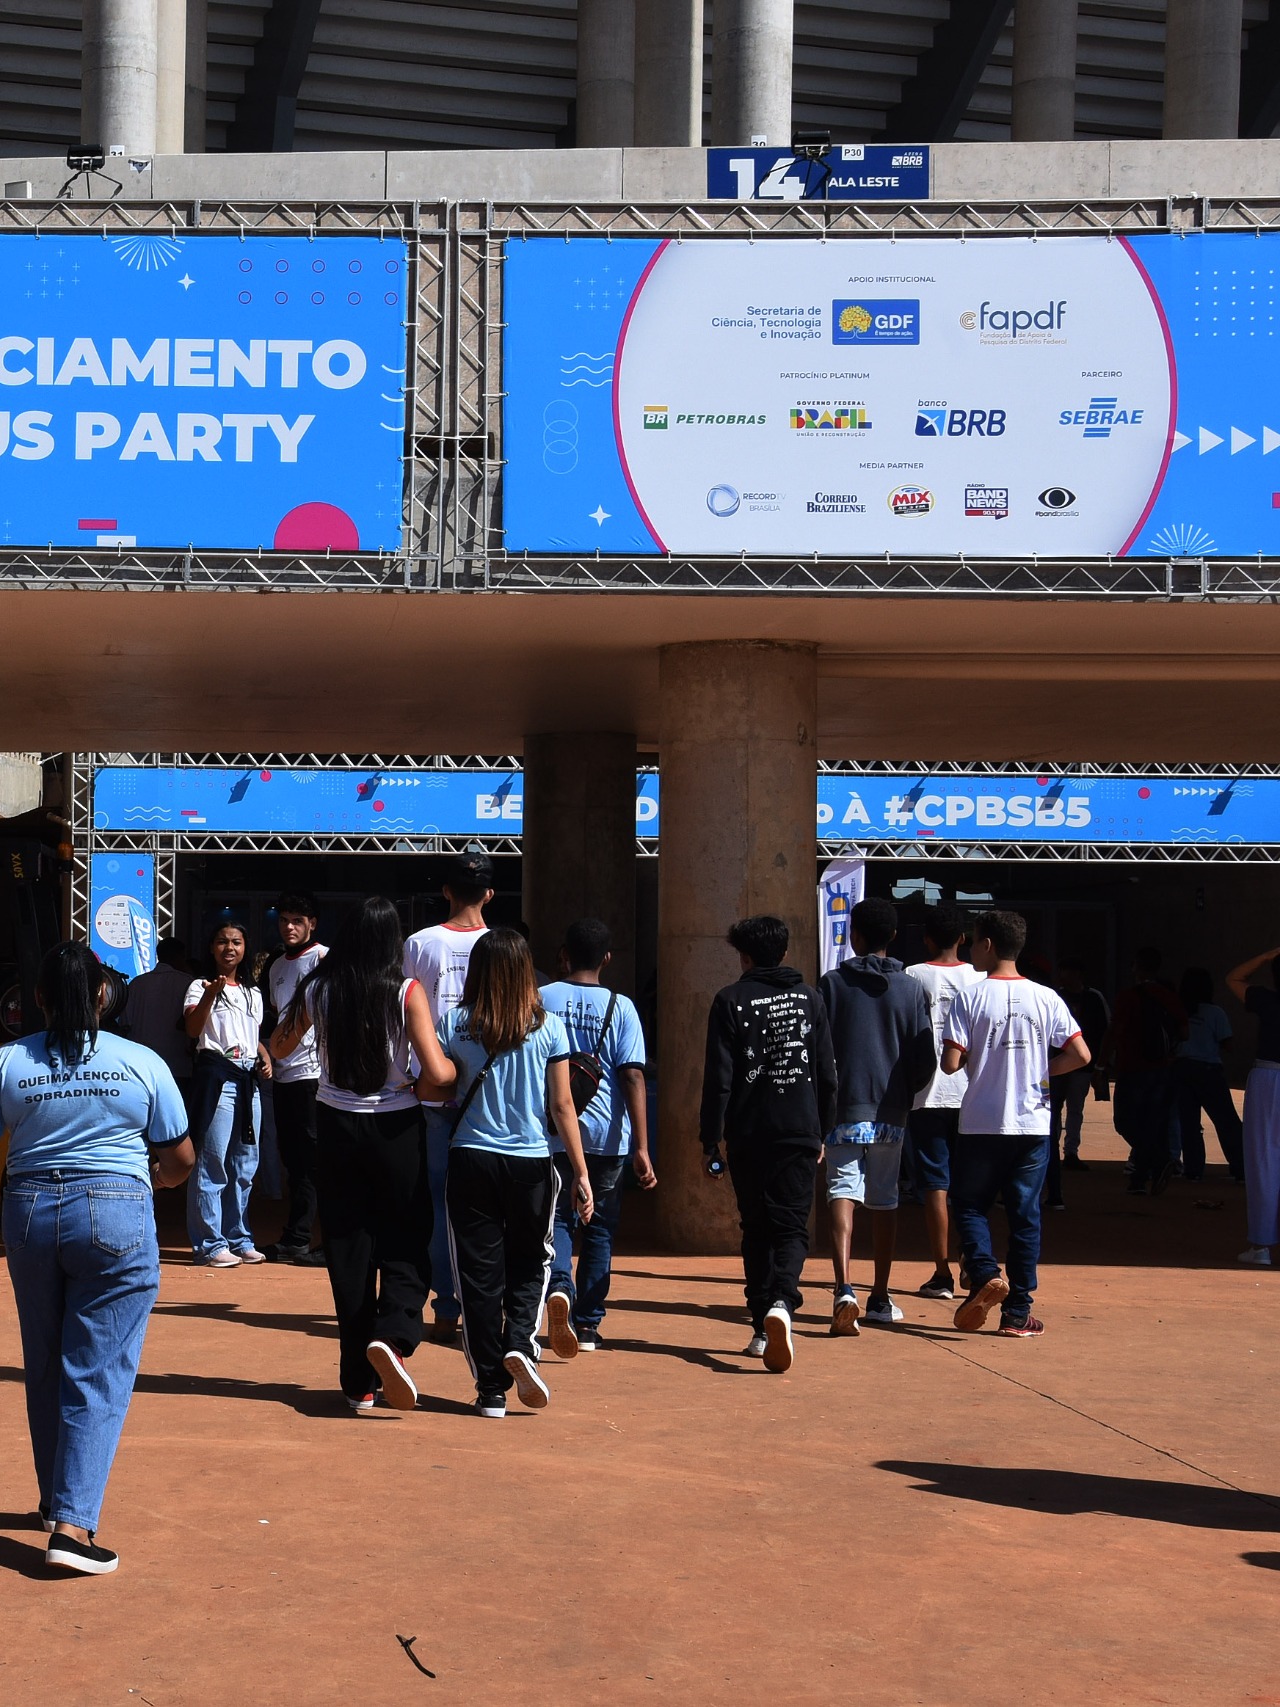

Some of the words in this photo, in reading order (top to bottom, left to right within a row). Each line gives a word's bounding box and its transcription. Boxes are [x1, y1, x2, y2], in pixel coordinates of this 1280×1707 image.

[843, 148, 862, 157] P30
[902, 155, 923, 165] BRB
[729, 158, 805, 200] 14
[828, 177, 856, 187] ALA
[859, 176, 899, 187] LESTE
[746, 305, 804, 316] Secretaria
[807, 305, 822, 316] de
[711, 317, 757, 329] Ciência,
[759, 317, 822, 330] Tecnologia
[874, 314, 914, 329] GDF
[979, 300, 1068, 338] fapdf
[760, 330, 767, 339] e
[770, 329, 822, 341] Inovação
[780, 371, 828, 379] PATROCÍNIO
[917, 399, 948, 407] banco
[645, 414, 667, 425] BR
[675, 414, 767, 425] PETROBRAS
[789, 408, 873, 429] BRASIL
[947, 409, 1007, 437] BRB
[1058, 409, 1145, 425] SEBRAE
[75, 411, 317, 463] PARTY
[814, 492, 858, 504] CORREIO
[891, 490, 931, 507] MIX
[966, 489, 1007, 499] BAND
[806, 502, 867, 513] BRAZILIENSE
[966, 498, 1007, 508] NEWS
[841, 791, 872, 824] À
[883, 794, 1092, 828] #CPBSB5
[17, 1072, 71, 1089] QUEIMA
[74, 1070, 129, 1083] LENÇOL
[24, 1087, 120, 1104] SOBRADINHO
